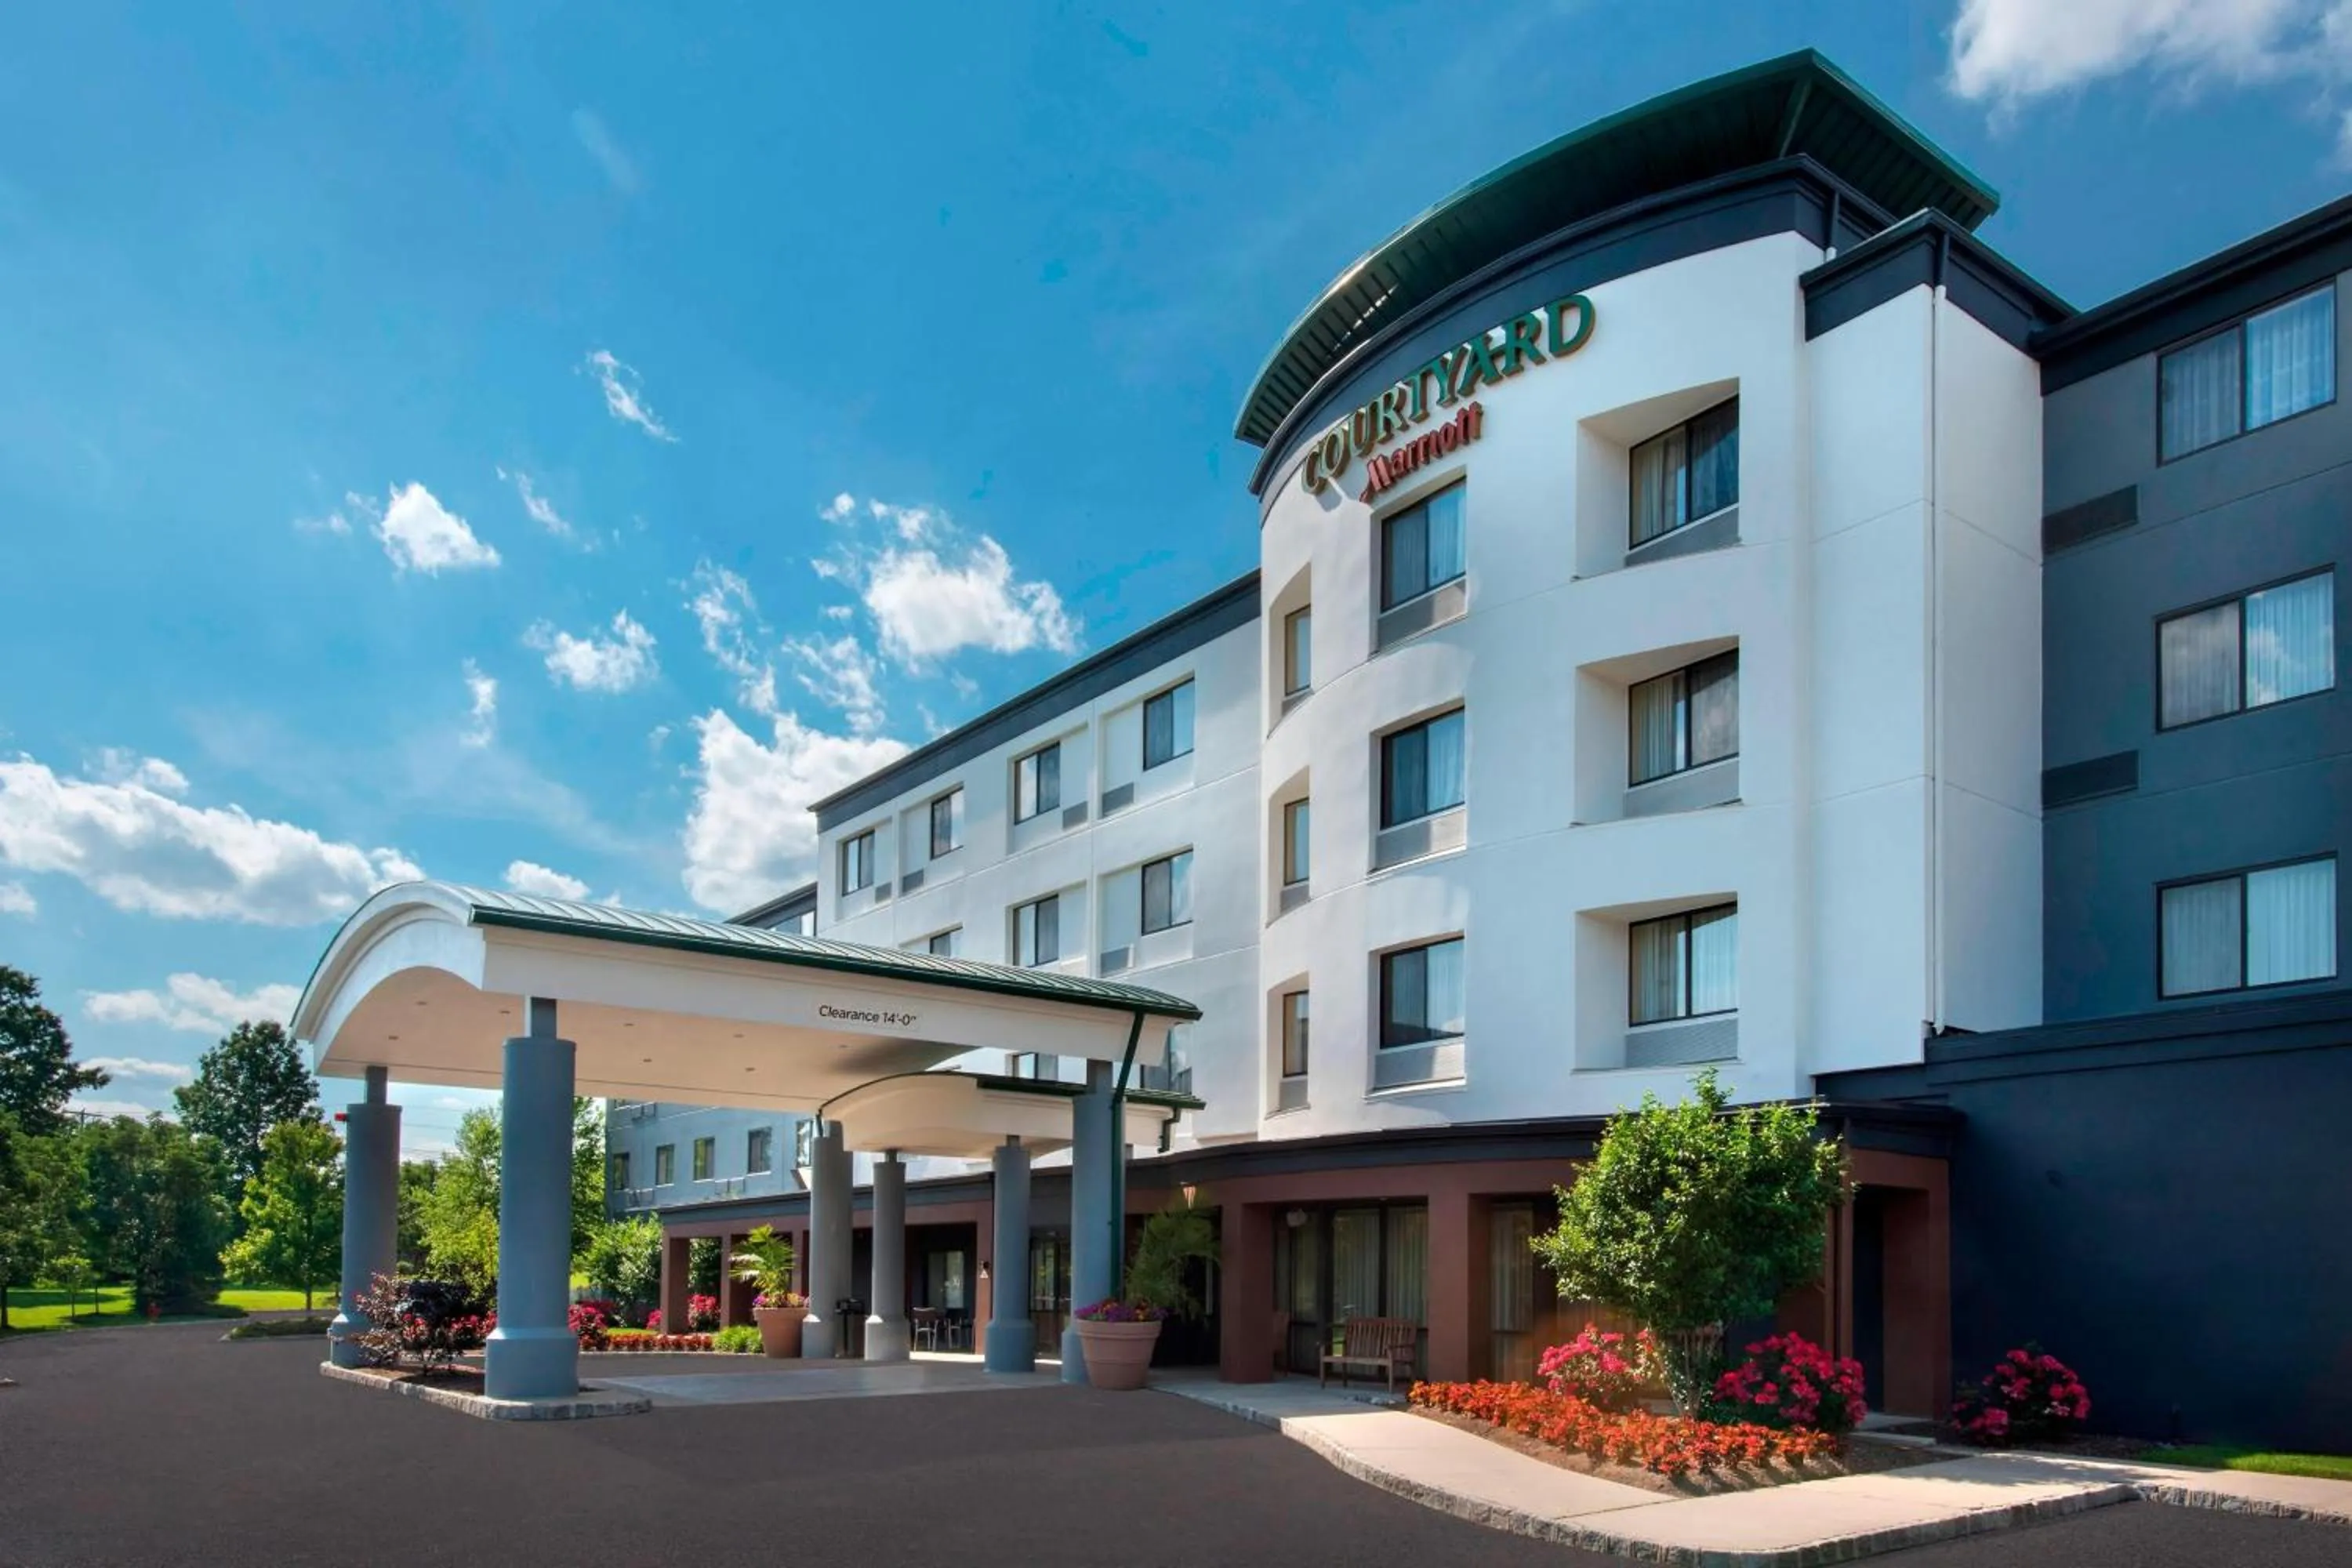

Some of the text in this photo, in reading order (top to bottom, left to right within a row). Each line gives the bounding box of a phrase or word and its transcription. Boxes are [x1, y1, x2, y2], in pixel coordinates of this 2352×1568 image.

[1301, 294, 1595, 495] COURTYARD
[1359, 401, 1483, 504] Marriott
[818, 1004, 880, 1023] Clearance
